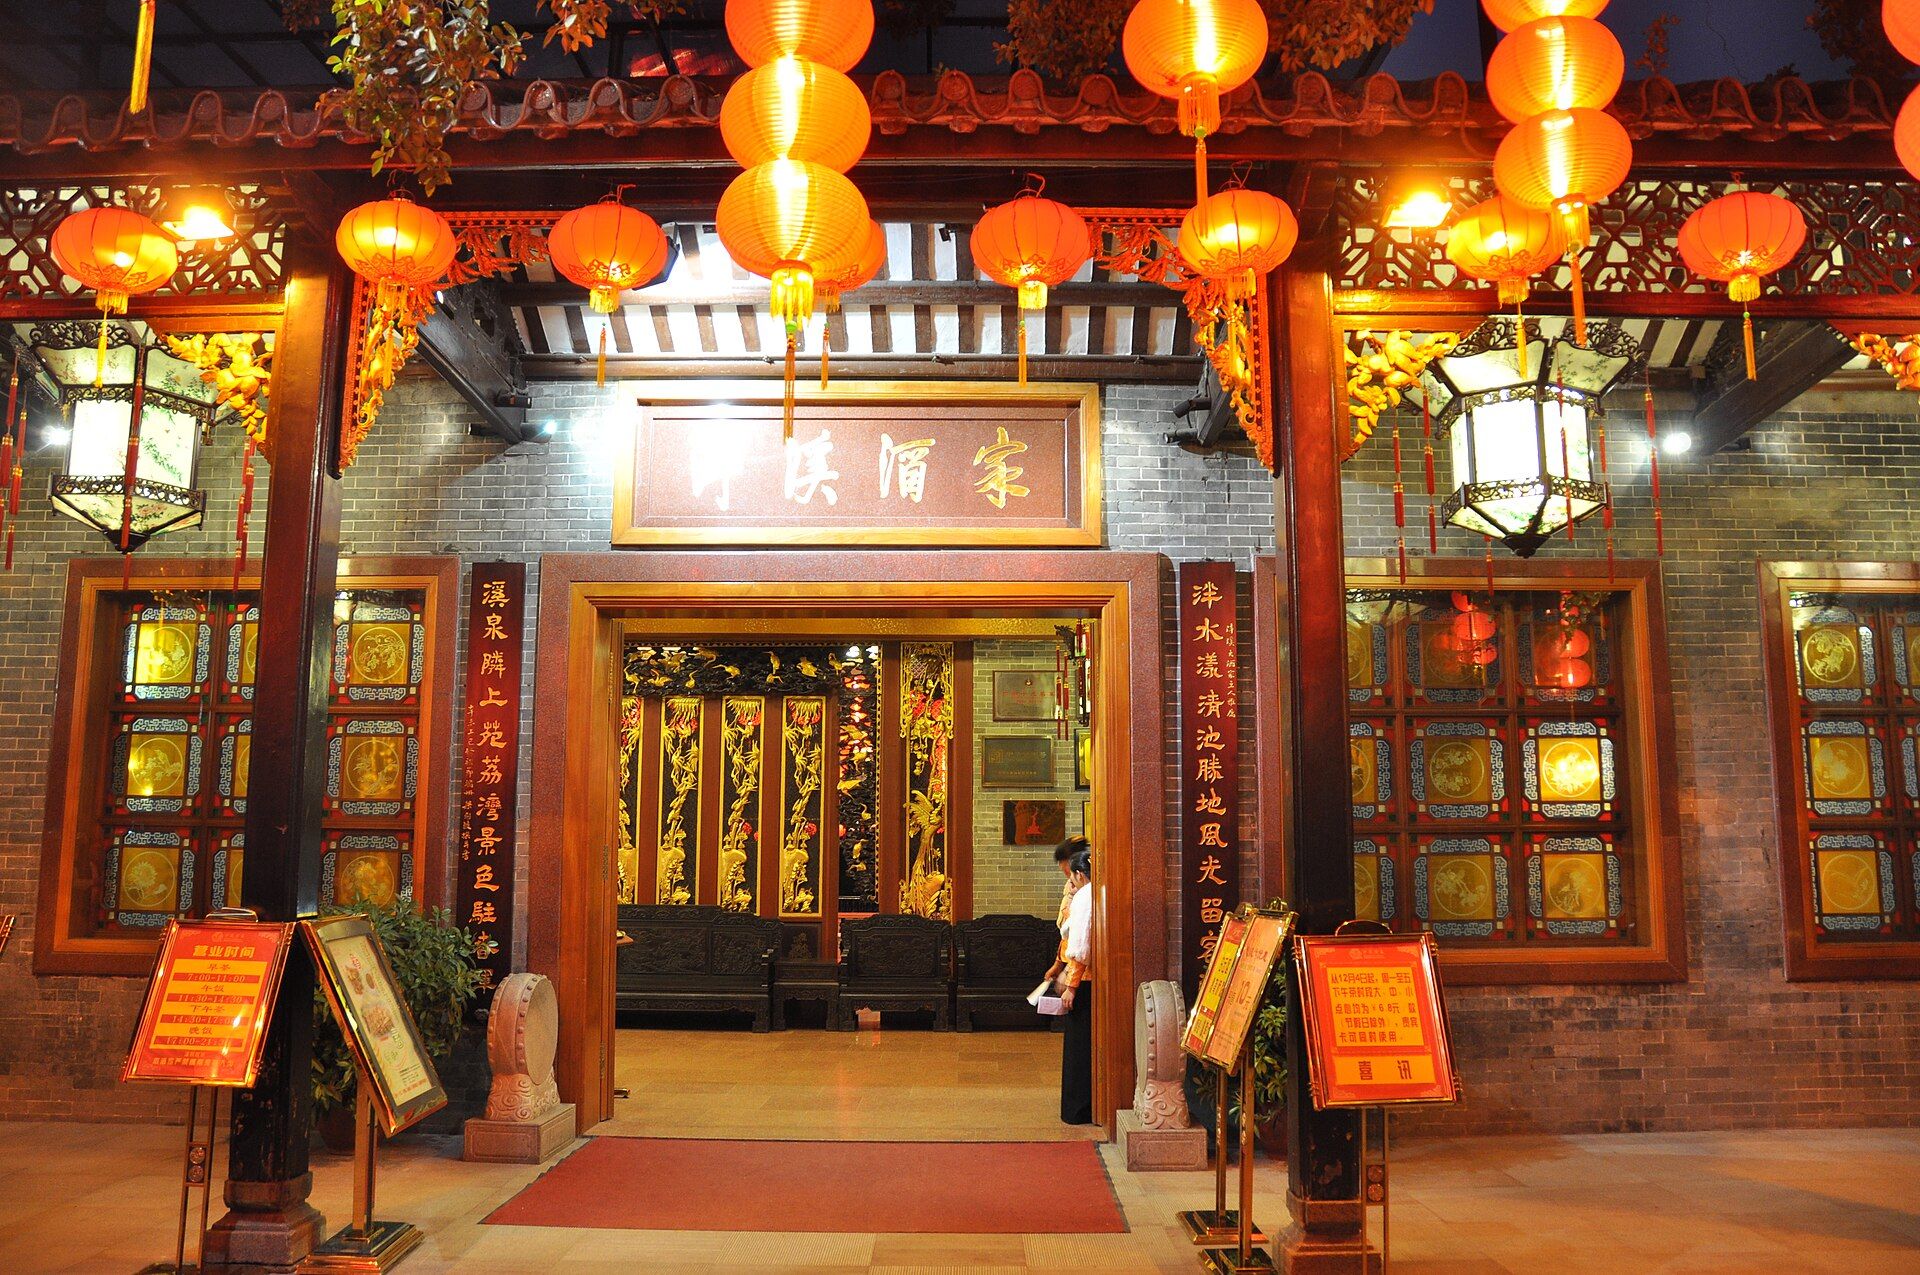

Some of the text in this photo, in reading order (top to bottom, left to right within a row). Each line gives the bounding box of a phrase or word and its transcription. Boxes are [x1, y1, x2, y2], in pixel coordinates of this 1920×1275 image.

[1192, 581, 1228, 988] 泮水漾清池勝地風光留客
[192, 945, 256, 959] 营业时间
[187, 973, 245, 983] 7:00-11:00
